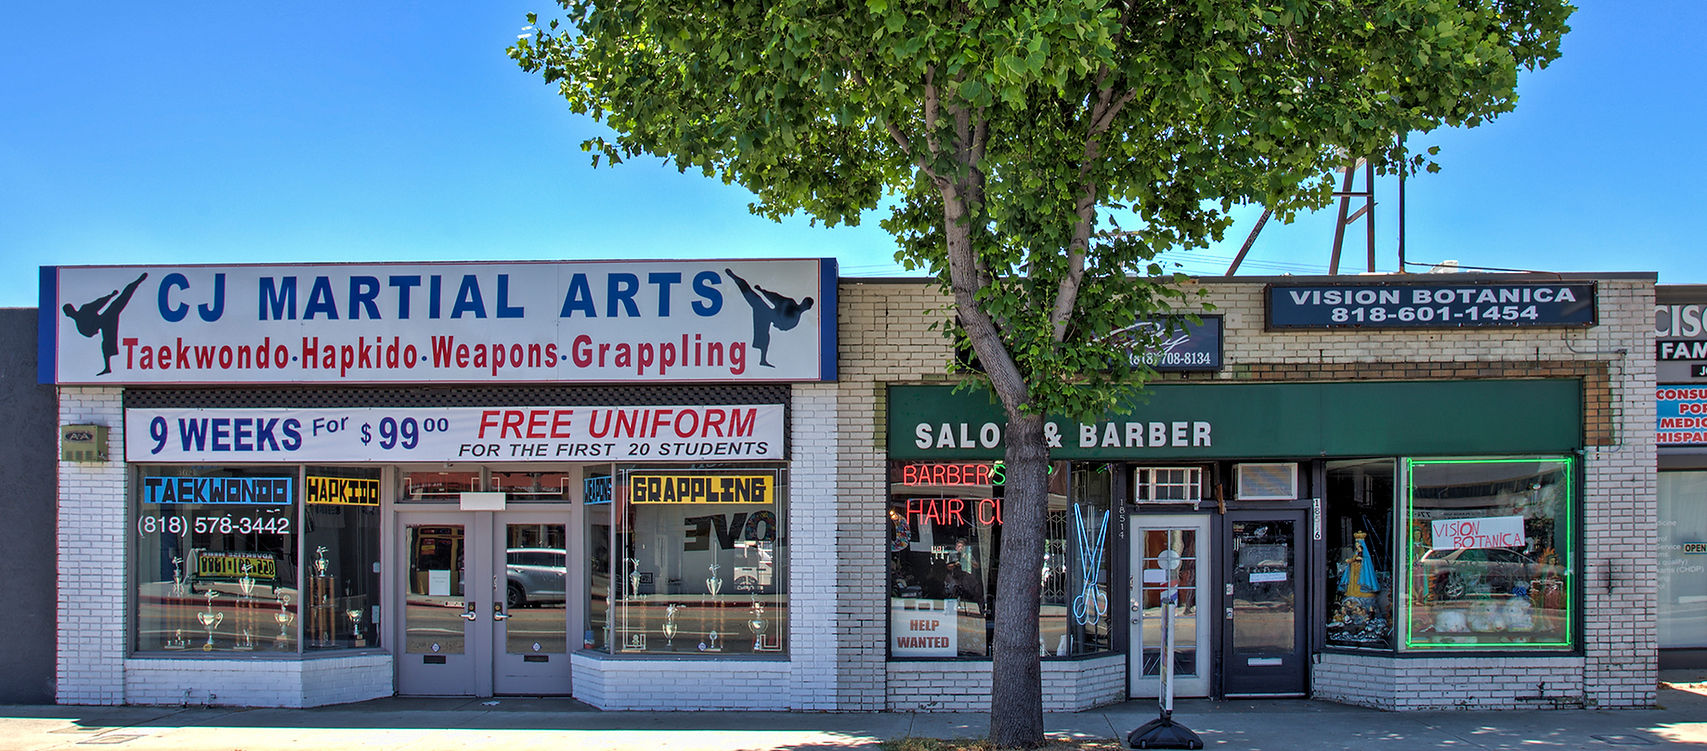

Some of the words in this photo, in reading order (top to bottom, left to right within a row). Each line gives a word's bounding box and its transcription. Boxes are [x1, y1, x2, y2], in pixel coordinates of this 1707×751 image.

[157, 272, 227, 322] CJ
[258, 273, 525, 320] MARTIAL
[560, 270, 724, 317] ARTS
[1289, 289, 1400, 305] VISION
[1412, 287, 1576, 304] BOTANICA
[1331, 305, 1538, 322] 818-601-1454
[122, 337, 289, 370] Taekwondo
[302, 336, 417, 377] Hapkido
[431, 335, 558, 376] Weapons
[572, 333, 746, 375] Grappling
[1161, 352, 1211, 365] 708-8134
[478, 409, 574, 440] FREE
[588, 407, 757, 439] UNIFORM
[150, 416, 168, 455] 9
[178, 418, 302, 451] WEEKS
[312, 415, 350, 437] For
[915, 422, 1007, 449] SALO
[1046, 421, 1063, 448] &
[1079, 421, 1212, 448] BARBER
[458, 443, 504, 457] FOR
[509, 443, 552, 457] THE
[556, 442, 615, 457] FIRST
[629, 442, 652, 456] 20
[658, 441, 769, 456] STUDENTS
[145, 478, 288, 503] TAEKWONDO
[307, 477, 380, 505] HAPKIDO
[632, 477, 767, 502] GRAPPLING
[906, 498, 964, 525] HAIR
[137, 515, 188, 537] (818)
[194, 517, 290, 534] 578-3442
[1433, 521, 1480, 537] VISION
[1453, 532, 1522, 549] BOTANICA
[1684, 543, 1707, 552] OPEN
[909, 619, 940, 631] HELP
[897, 636, 950, 649] WANTED
